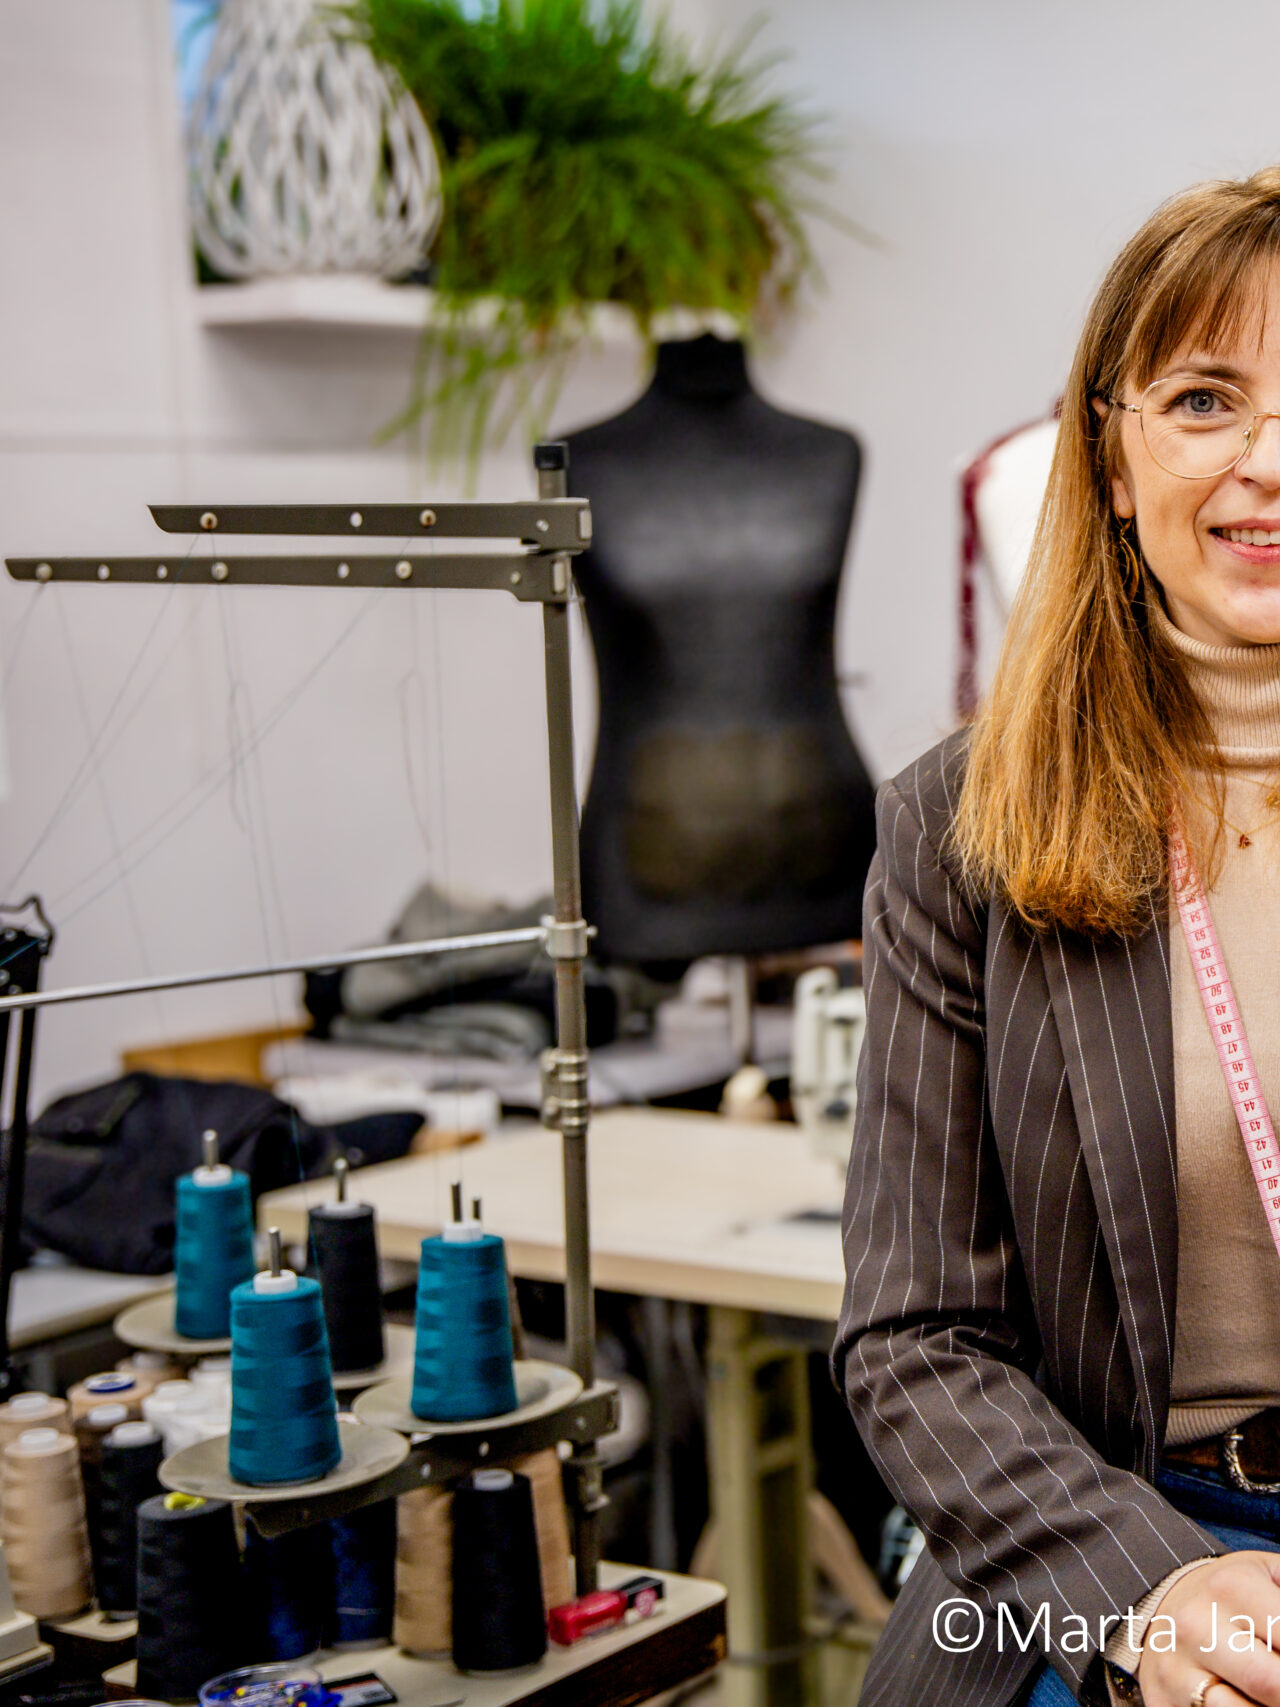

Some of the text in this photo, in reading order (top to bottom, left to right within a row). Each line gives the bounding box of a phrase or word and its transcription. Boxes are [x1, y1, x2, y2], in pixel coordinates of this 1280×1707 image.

[1190, 913, 1201, 923] 54
[1195, 931, 1206, 941] 53
[1200, 949, 1211, 959] 52
[1206, 968, 1217, 978] 51
[1211, 986, 1222, 996] 50
[1216, 1005, 1227, 1015] 49
[1221, 1024, 1232, 1034] 48
[1228, 1043, 1238, 1054] 47
[1232, 1063, 1244, 1073] 46
[1238, 1082, 1250, 1092] 45
[1244, 1101, 1255, 1112] 44
[1250, 1121, 1261, 1131] 43
[1256, 1140, 1267, 1151] 42
[1262, 1160, 1272, 1170] 41
[1267, 1179, 1279, 1190] 40
